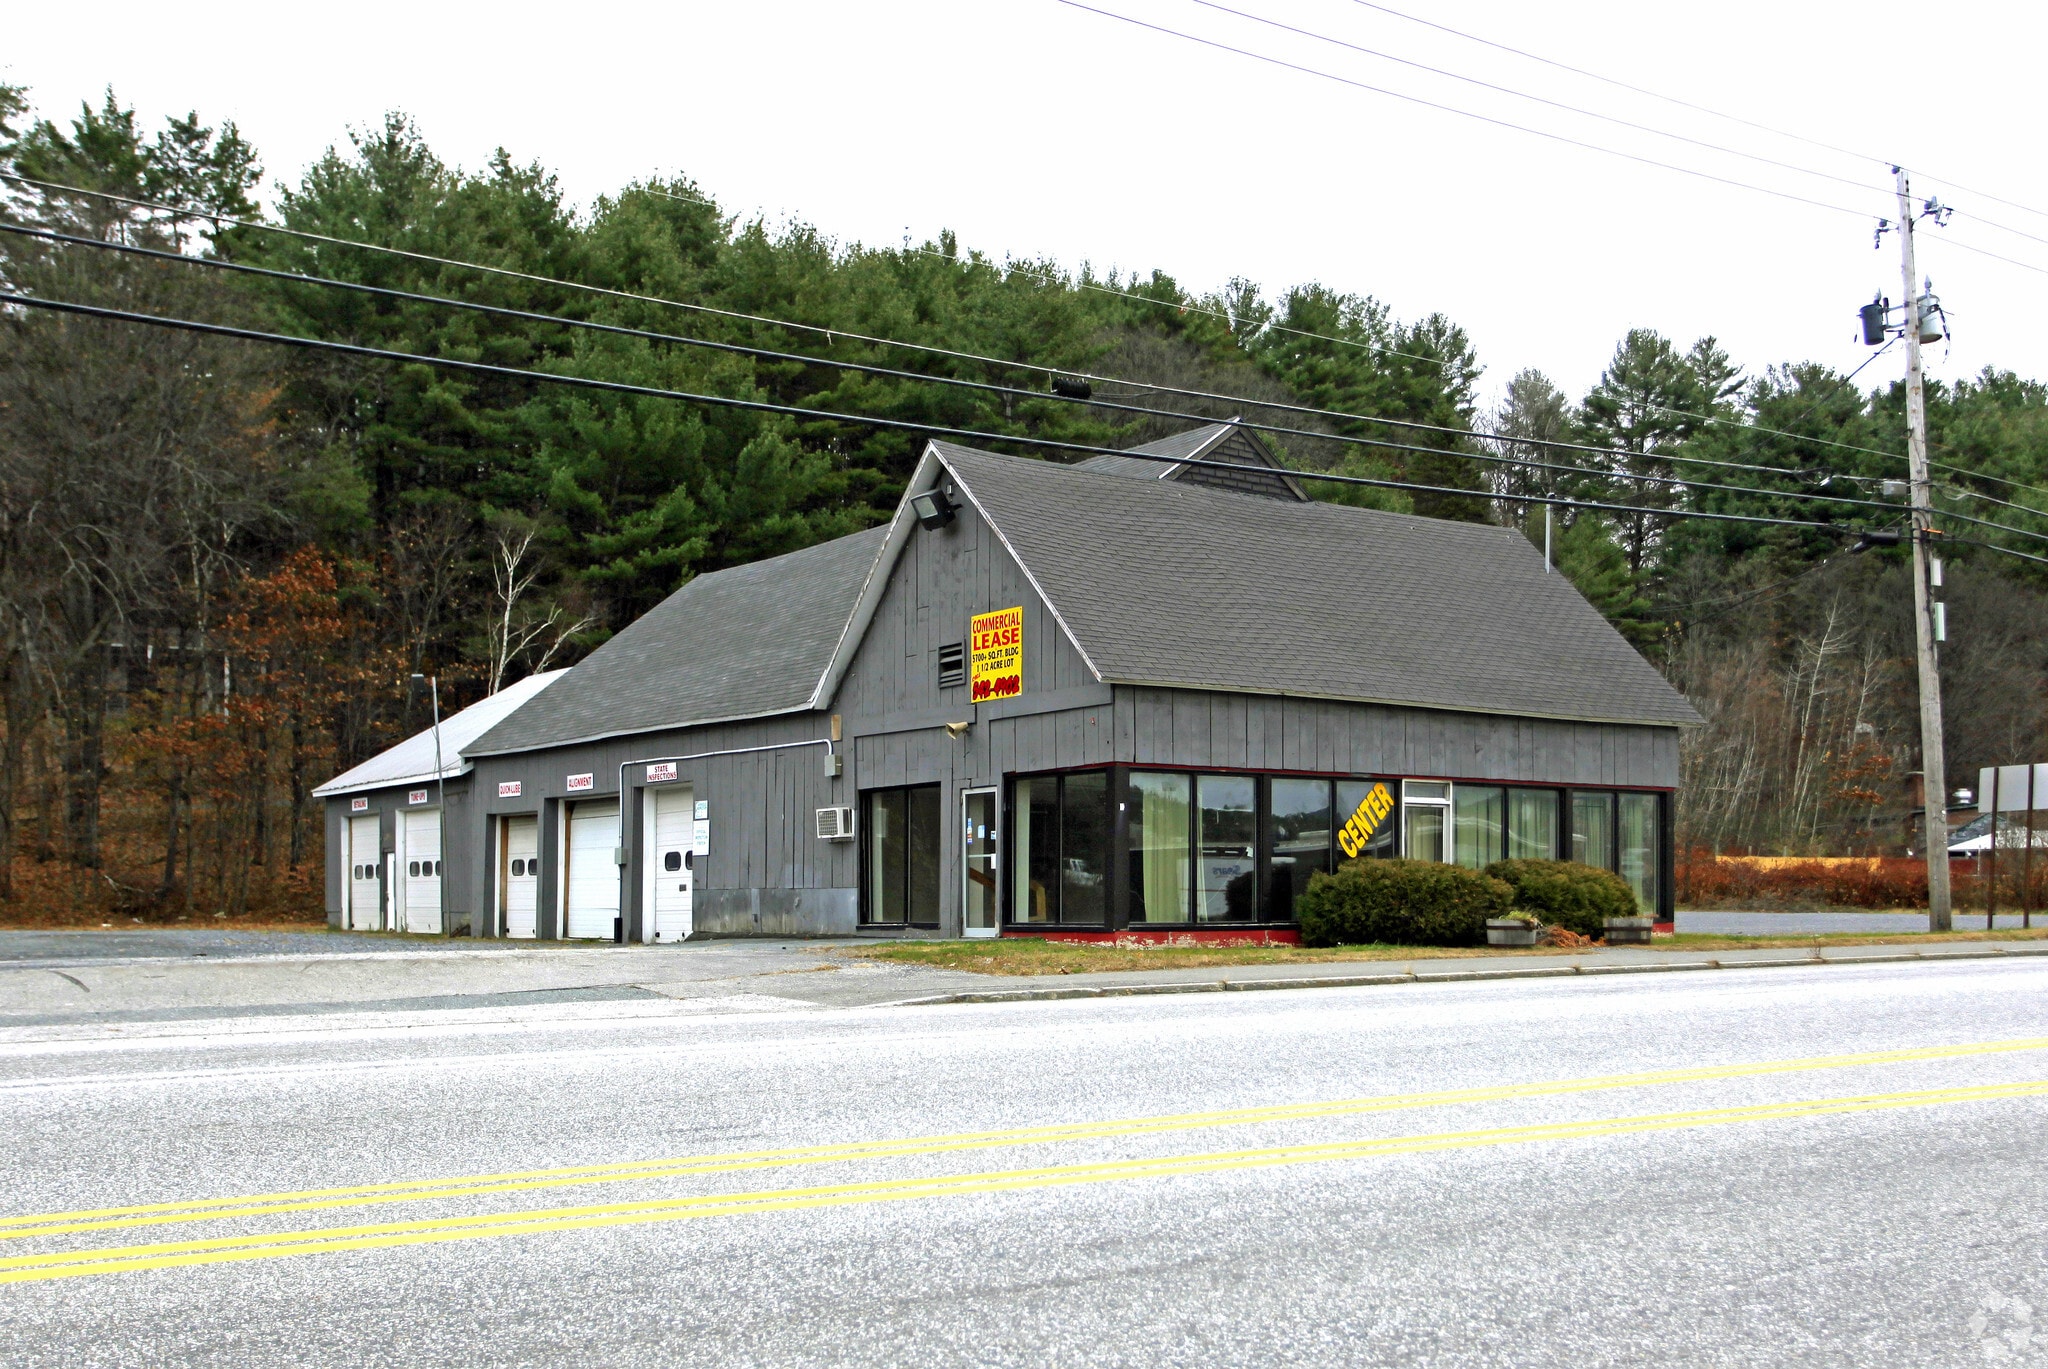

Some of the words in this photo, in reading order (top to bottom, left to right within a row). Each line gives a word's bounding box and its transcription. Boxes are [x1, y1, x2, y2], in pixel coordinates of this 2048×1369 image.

[973, 612, 1020, 634] COMMERCIAL
[973, 628, 1020, 651] LEASE
[1005, 646, 1019, 657] BLDG
[981, 663, 989, 672] 1/2
[990, 660, 1003, 671] ACRE
[1004, 658, 1014, 668] LOT
[654, 765, 669, 773] STATE
[568, 776, 592, 788] ALIGNMENT
[648, 771, 677, 781] INSPECTIONS
[1338, 782, 1395, 858] CENTER
